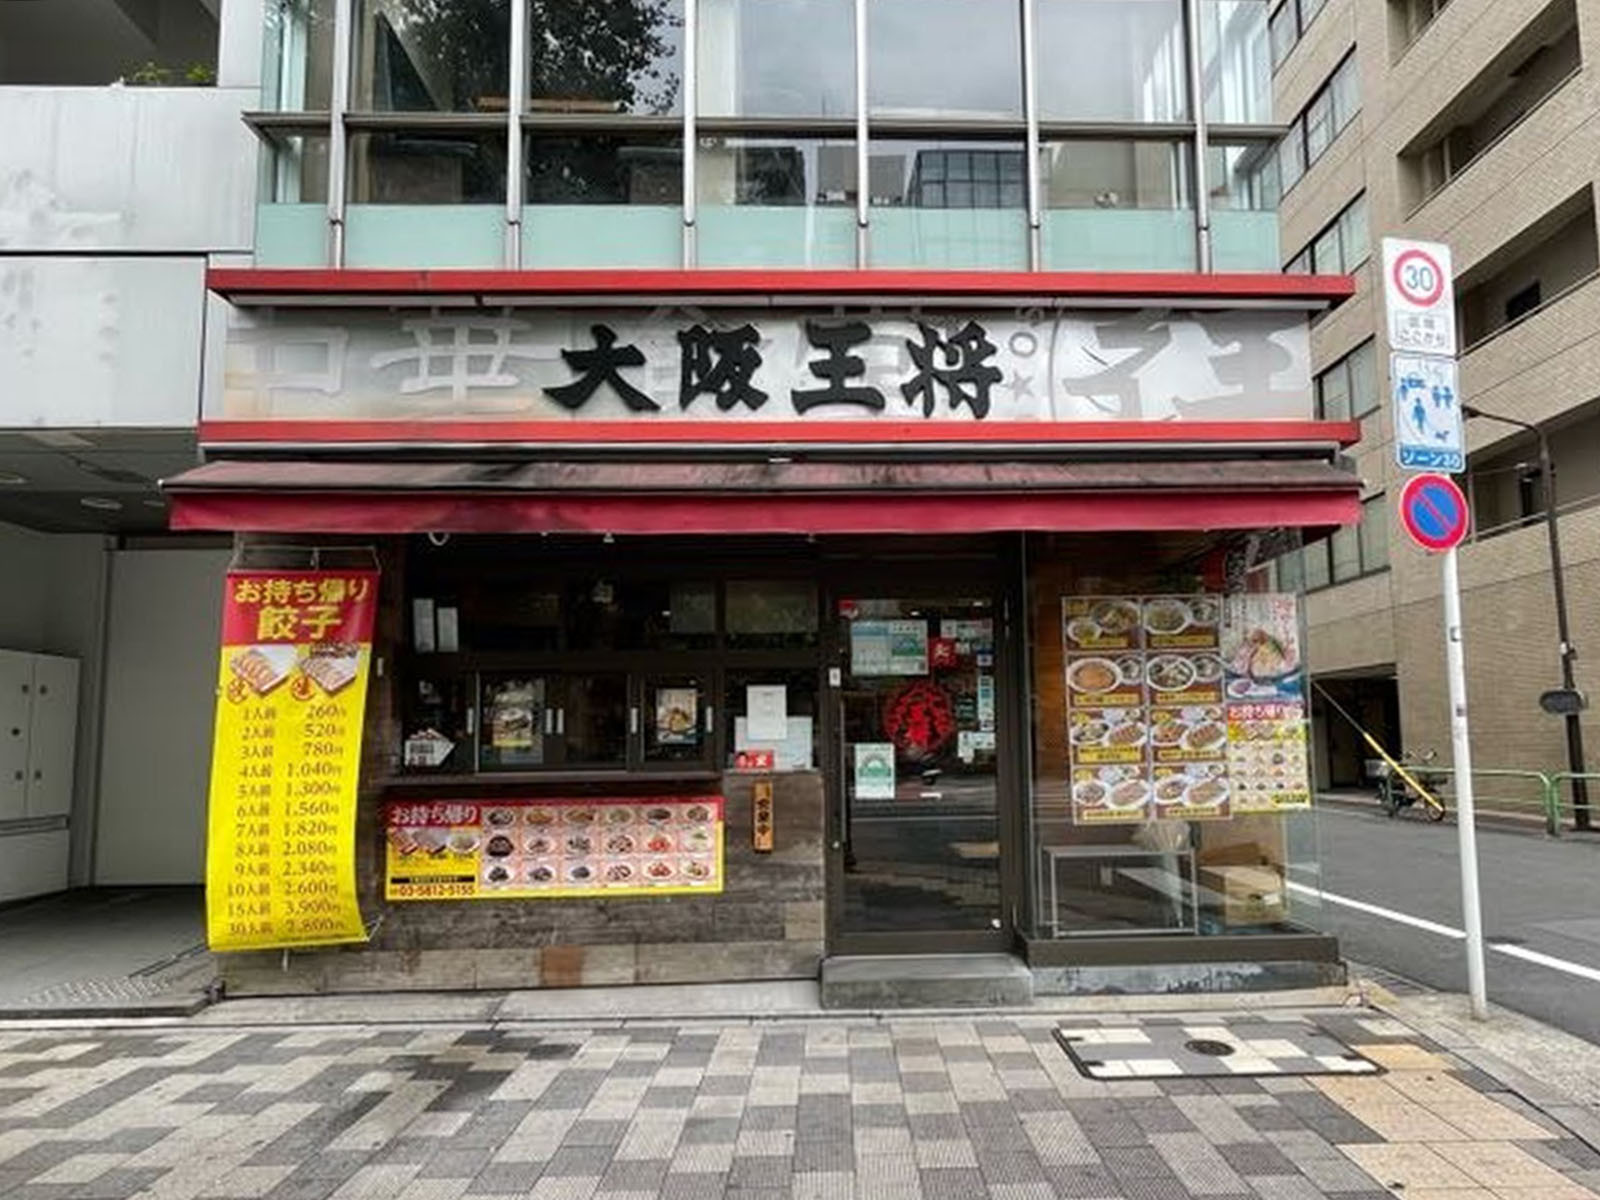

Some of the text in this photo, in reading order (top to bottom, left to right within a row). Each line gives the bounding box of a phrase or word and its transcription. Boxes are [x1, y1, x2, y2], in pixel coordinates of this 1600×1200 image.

[1404, 265, 1434, 292] 30
[1399, 328, 1446, 347] ここから
[541, 321, 1002, 420] 大阪王将
[1401, 448, 1462, 469] ゾーン30
[234, 577, 370, 604] お持ち帰り
[257, 604, 343, 641] 餃子
[391, 803, 478, 825] お持ち帰り
